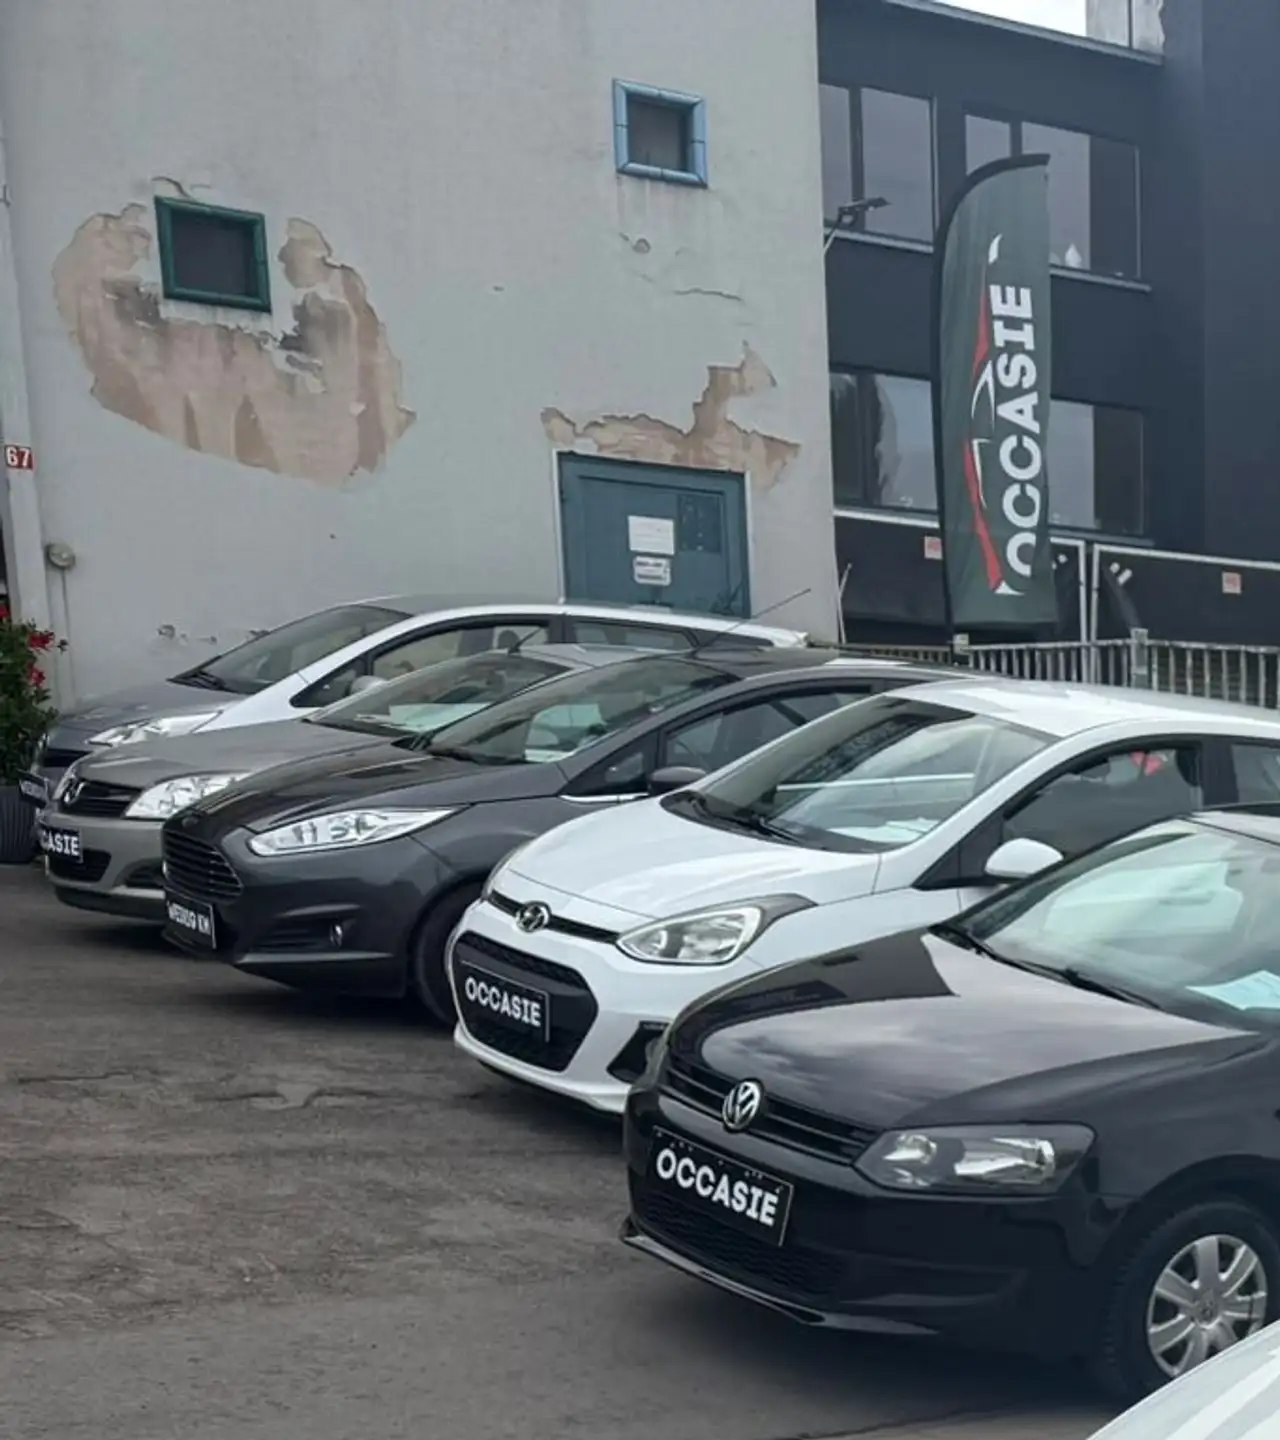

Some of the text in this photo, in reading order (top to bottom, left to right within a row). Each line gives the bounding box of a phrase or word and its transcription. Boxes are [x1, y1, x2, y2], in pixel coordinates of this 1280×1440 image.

[5, 446, 30, 467] 67
[990, 284, 1043, 577] OCCASIE
[465, 976, 541, 1028] OCCASIE
[656, 1149, 779, 1227] OCCASIE
